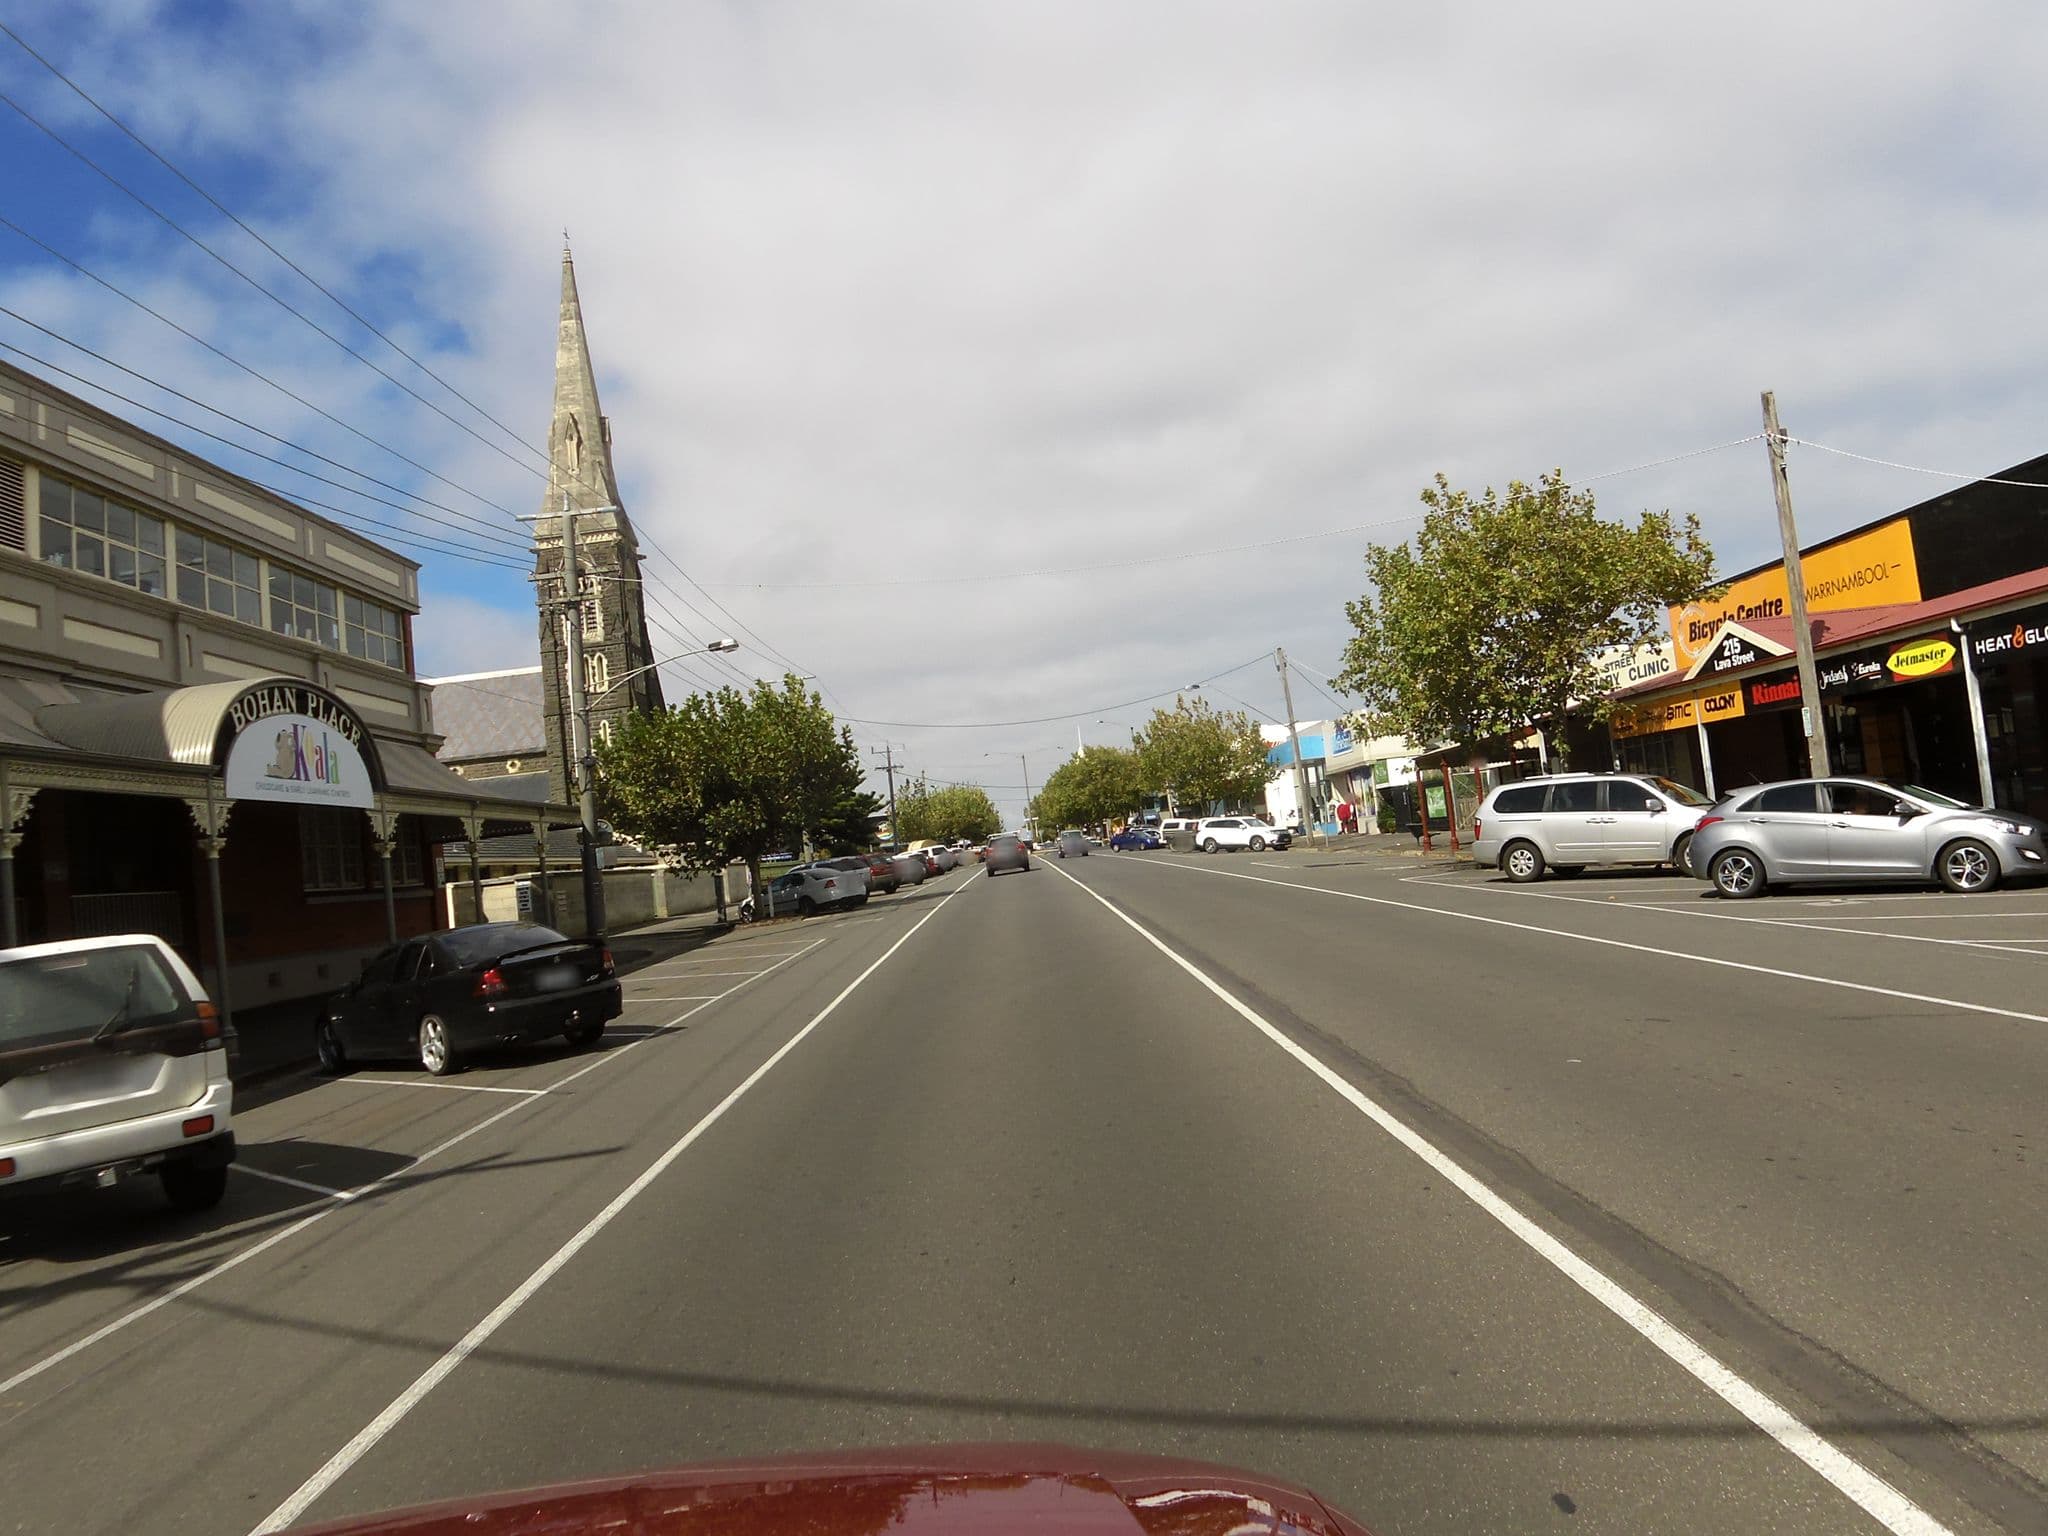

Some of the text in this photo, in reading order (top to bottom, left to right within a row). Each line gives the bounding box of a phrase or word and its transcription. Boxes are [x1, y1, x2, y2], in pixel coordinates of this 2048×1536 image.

[1804, 562, 1889, 603] WARRNAMBOOL
[1737, 597, 1783, 622] Centre
[1723, 637, 1741, 657] 215
[1894, 648, 1946, 667] Jetmaster
[1604, 655, 1637, 673] STREET
[1628, 657, 1670, 681] CLINIC
[1714, 650, 1755, 671] Lava Street
[1704, 693, 1736, 713] COLONY
[229, 687, 361, 751] BOHAN PLACE
